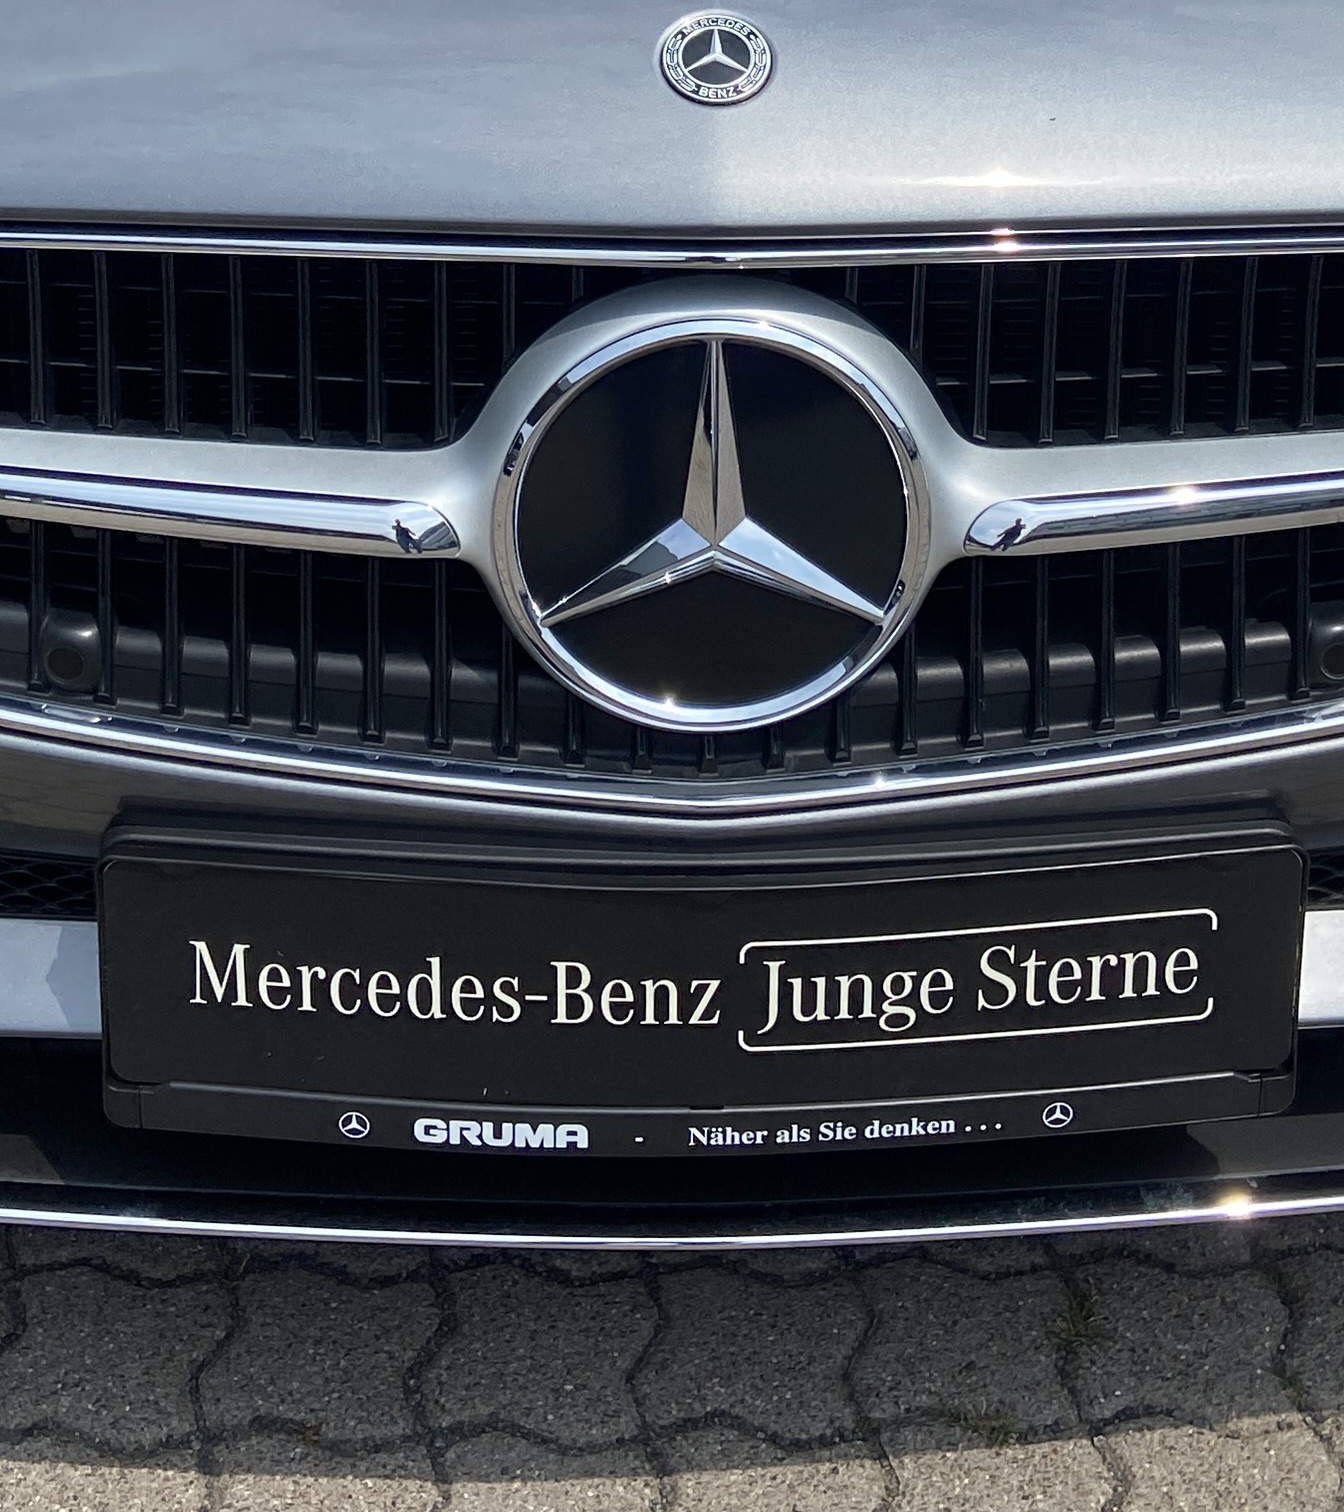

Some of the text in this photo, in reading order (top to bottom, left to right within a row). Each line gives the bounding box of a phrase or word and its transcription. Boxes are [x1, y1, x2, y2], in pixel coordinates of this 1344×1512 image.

[682, 18, 750, 36] MERCEDES
[699, 87, 736, 98] BENZ
[189, 940, 1199, 1034] Mercedes-Benz Junge Sterne
[414, 1118, 589, 1149] GRUMA
[688, 1126, 768, 1146] Näher
[776, 1124, 810, 1144] als
[818, 1121, 857, 1142] Sie
[864, 1117, 956, 1140] denken
